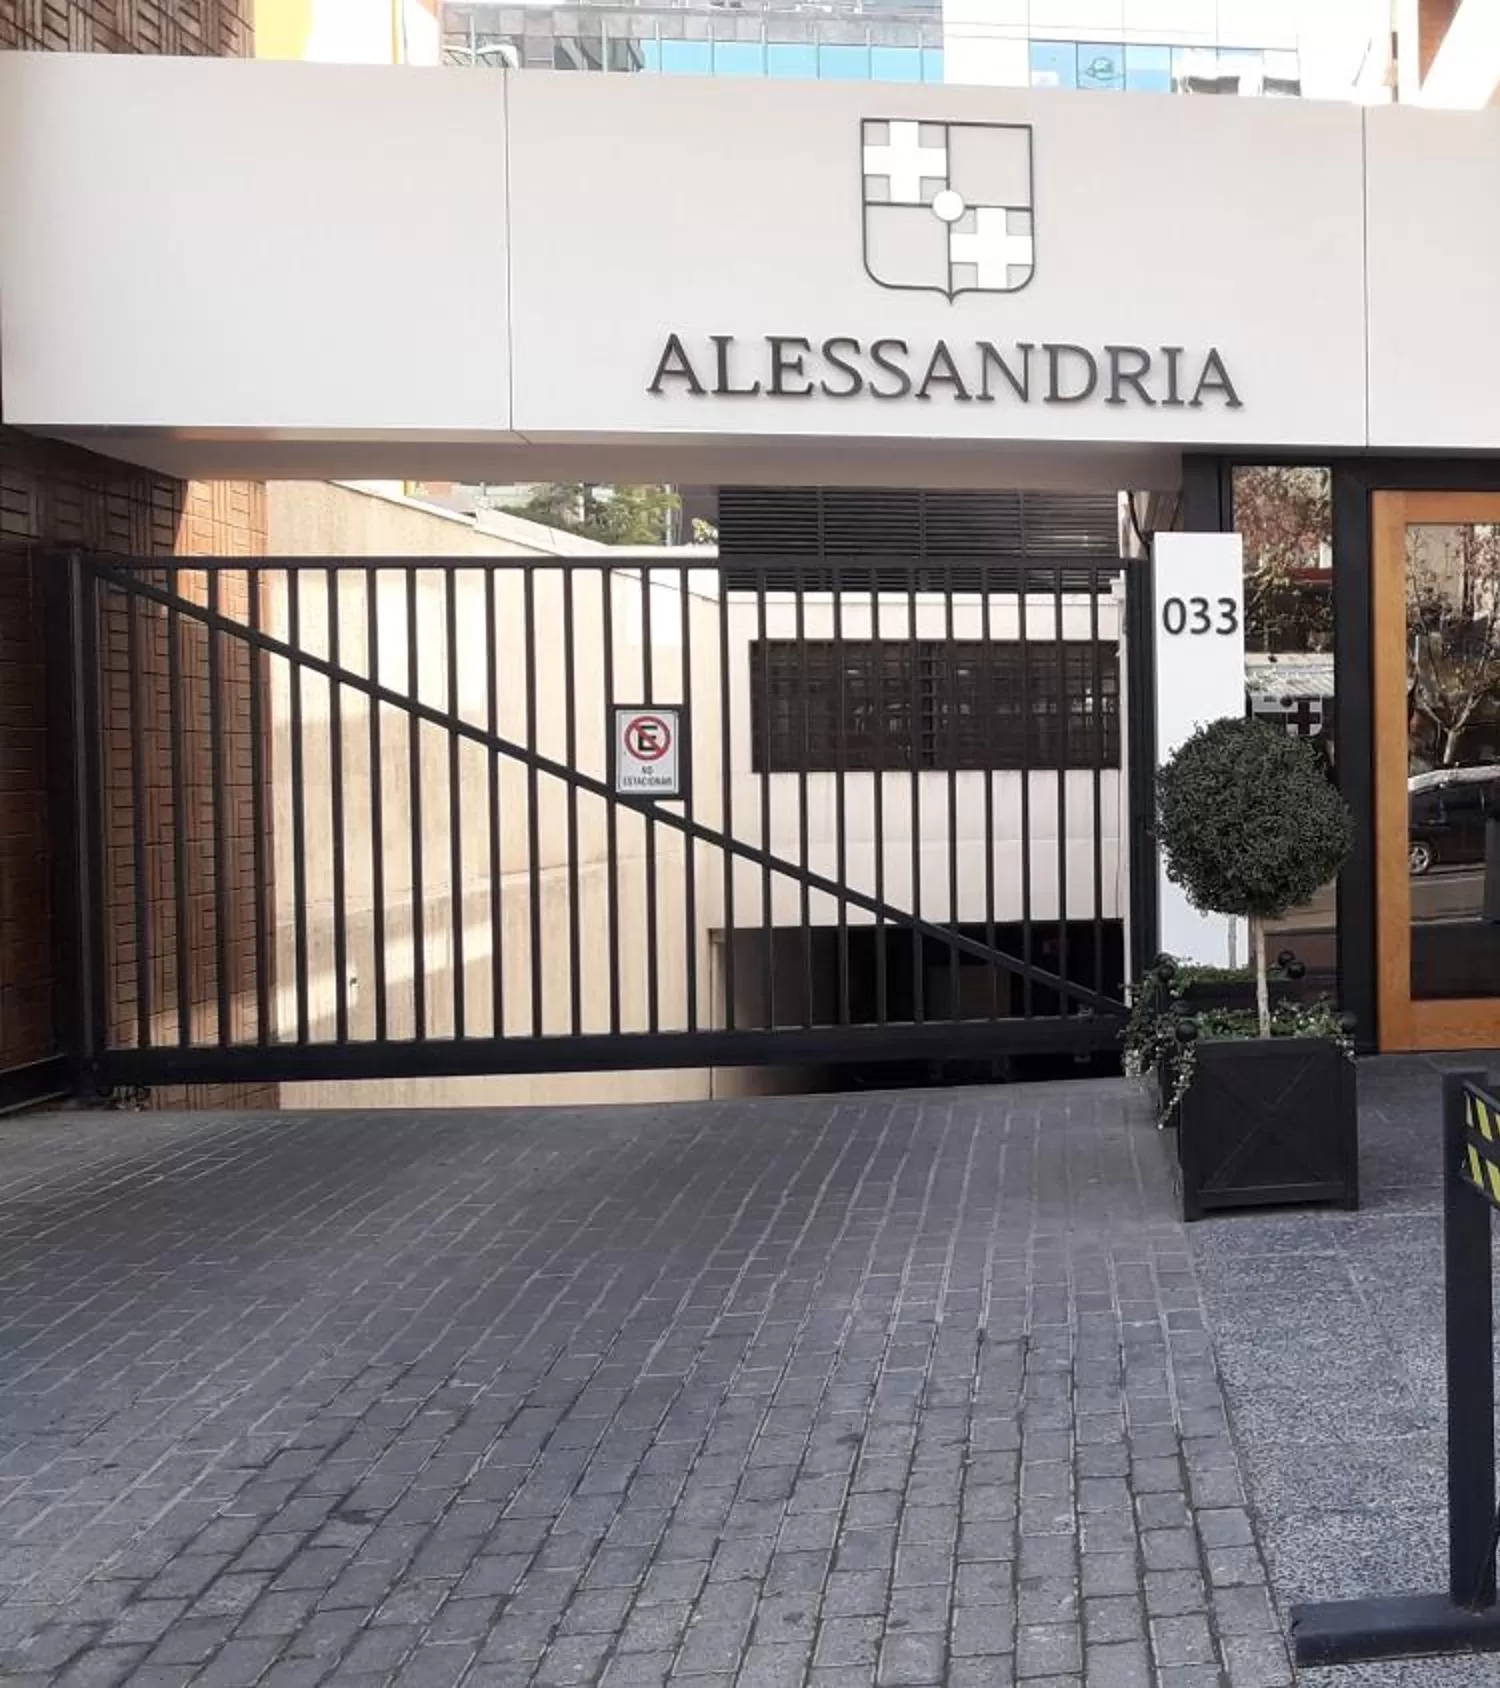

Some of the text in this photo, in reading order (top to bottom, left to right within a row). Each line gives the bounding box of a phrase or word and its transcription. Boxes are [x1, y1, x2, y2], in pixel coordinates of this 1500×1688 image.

[646, 332, 1243, 407] ALESSANDRIA
[1162, 597, 1238, 635] 033
[641, 765, 655, 775] NO
